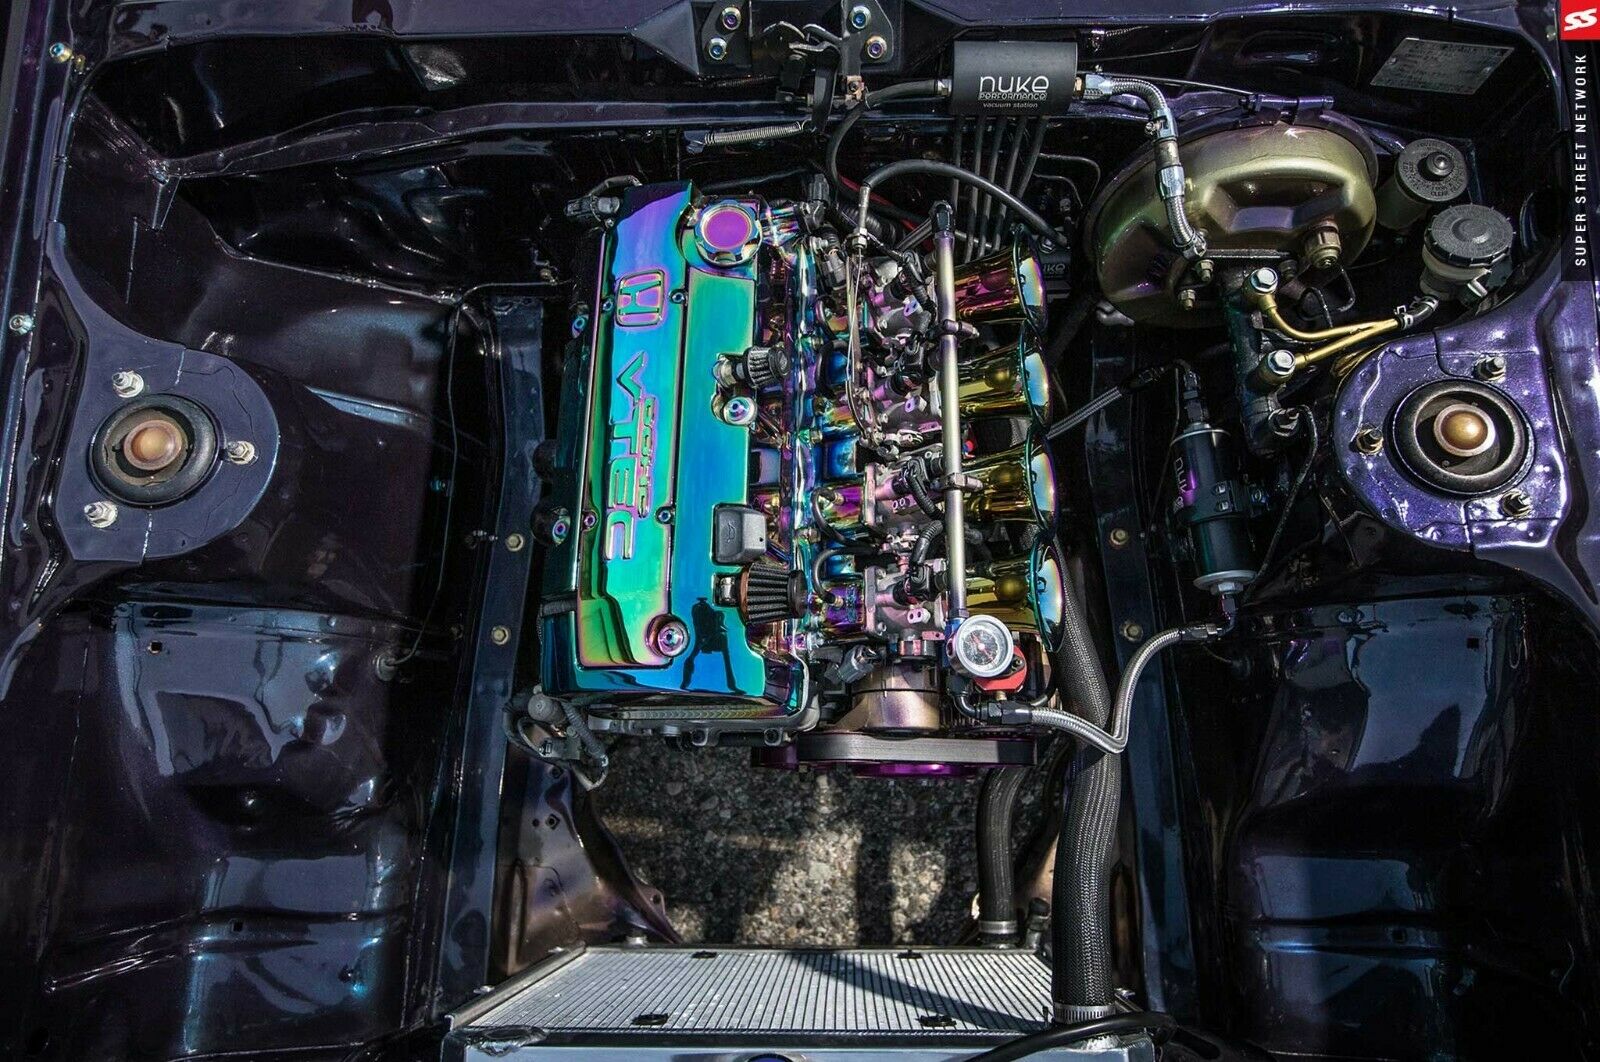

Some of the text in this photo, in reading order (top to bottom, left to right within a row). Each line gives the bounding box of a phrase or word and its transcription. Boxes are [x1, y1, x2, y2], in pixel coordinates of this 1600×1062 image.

[979, 75, 1049, 93] nuke
[605, 351, 645, 559] VTEC
[637, 397, 655, 518] DOHC
